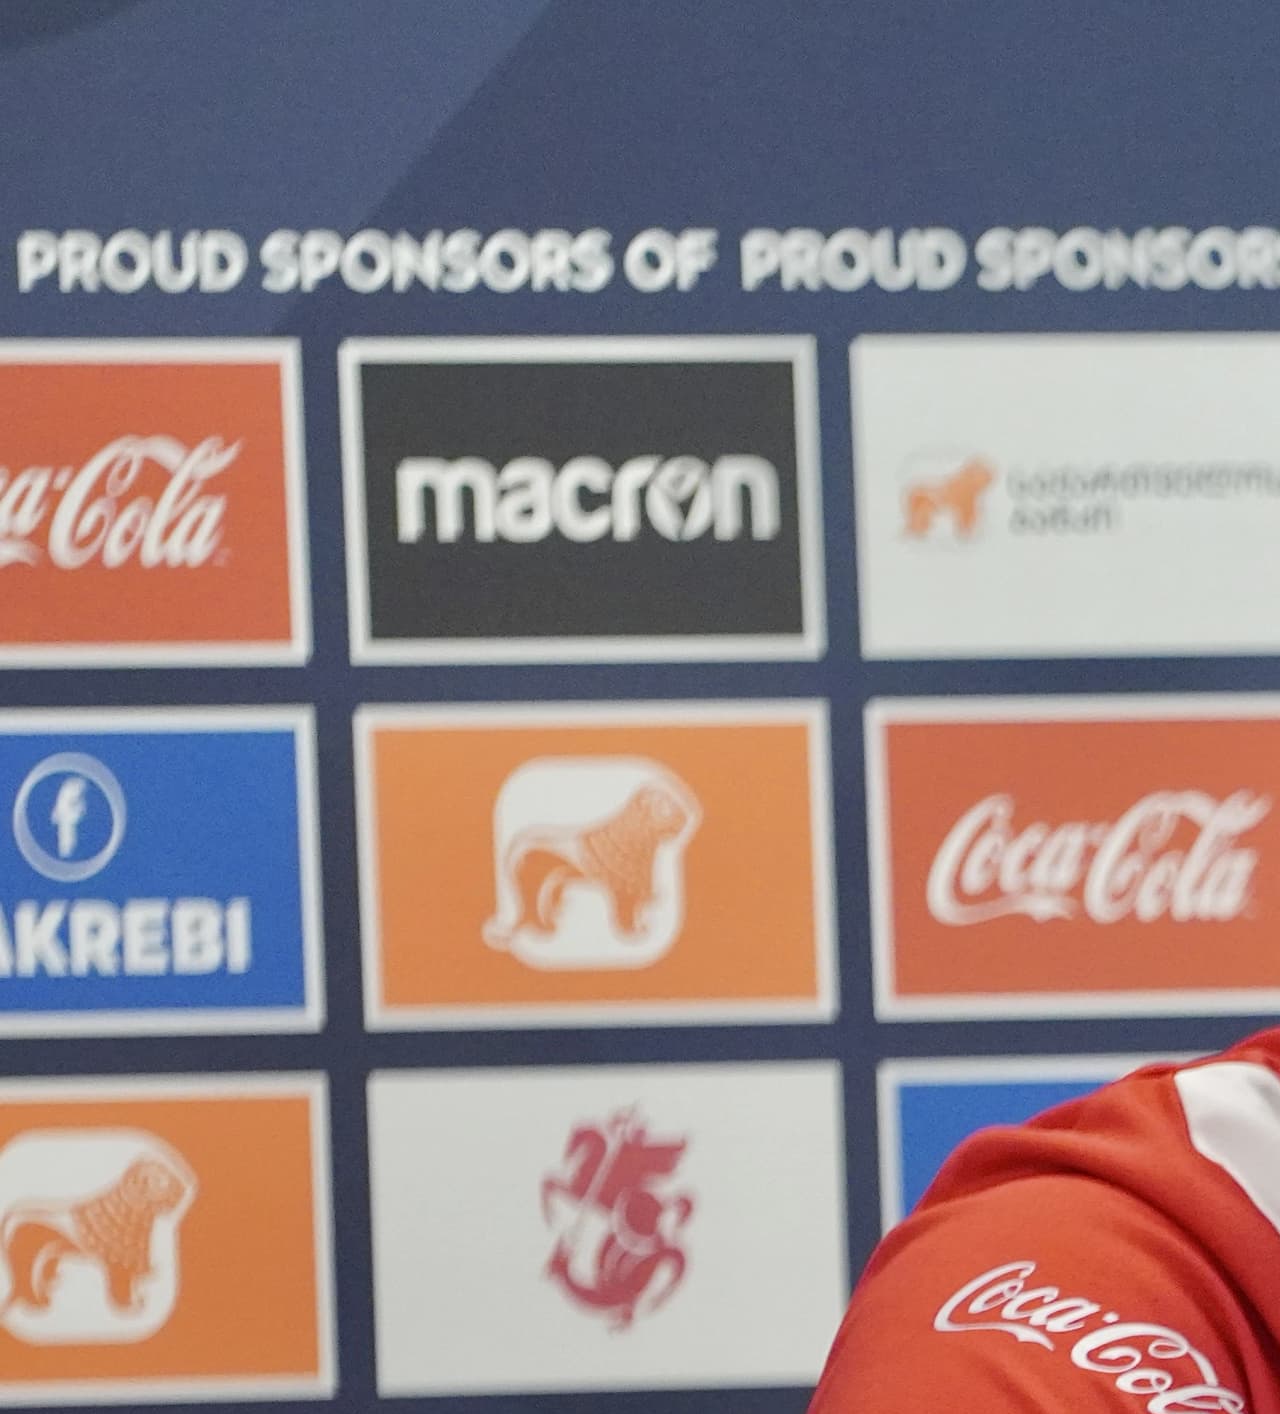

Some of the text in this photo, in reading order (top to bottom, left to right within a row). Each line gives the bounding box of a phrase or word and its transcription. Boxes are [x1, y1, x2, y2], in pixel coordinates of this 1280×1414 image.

[17, 230, 248, 293] PROUD
[260, 229, 614, 292] SPONSORS
[624, 229, 716, 291] OF
[741, 228, 966, 291] PROUD
[397, 456, 779, 542] macron
[0, 898, 250, 976] KREBI
